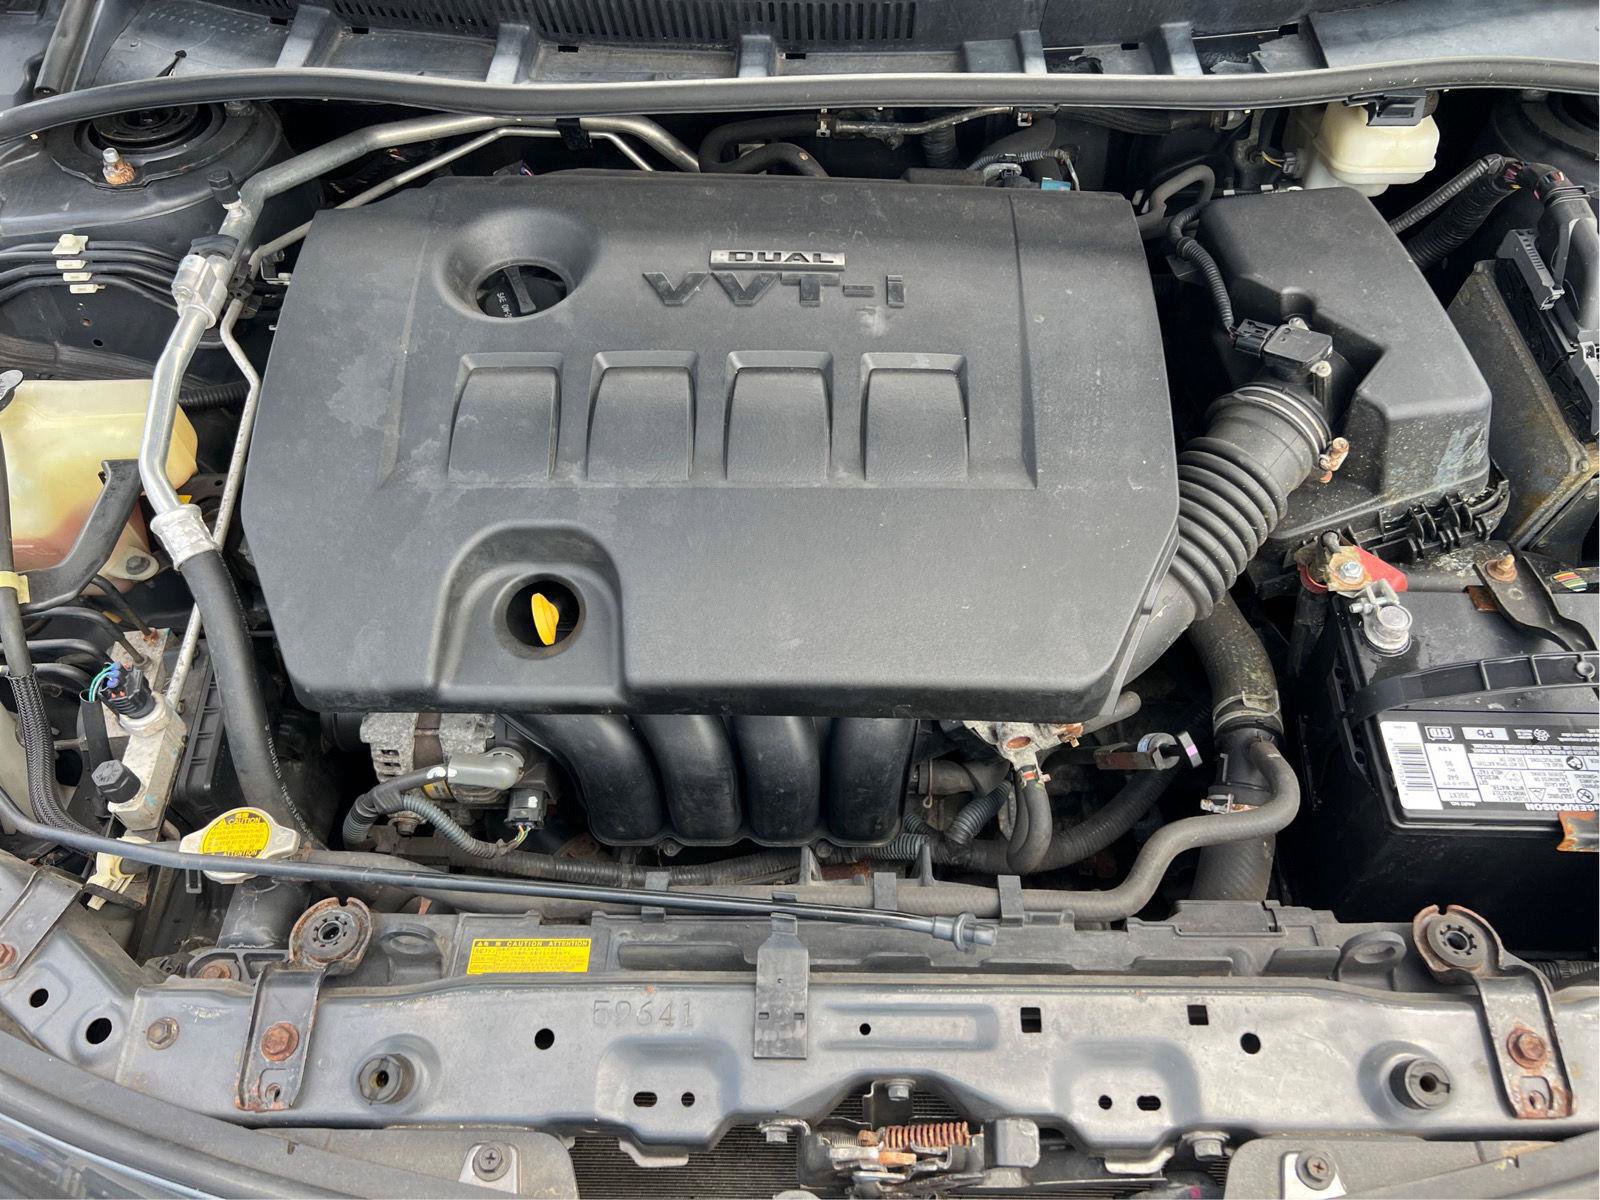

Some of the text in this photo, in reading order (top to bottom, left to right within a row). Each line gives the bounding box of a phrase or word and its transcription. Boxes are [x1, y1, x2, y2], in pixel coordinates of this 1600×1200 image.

[728, 251, 834, 264] DUAL
[496, 292, 507, 303] SAE
[1477, 729, 1494, 739] Pb
[228, 817, 261, 825] CAUTION
